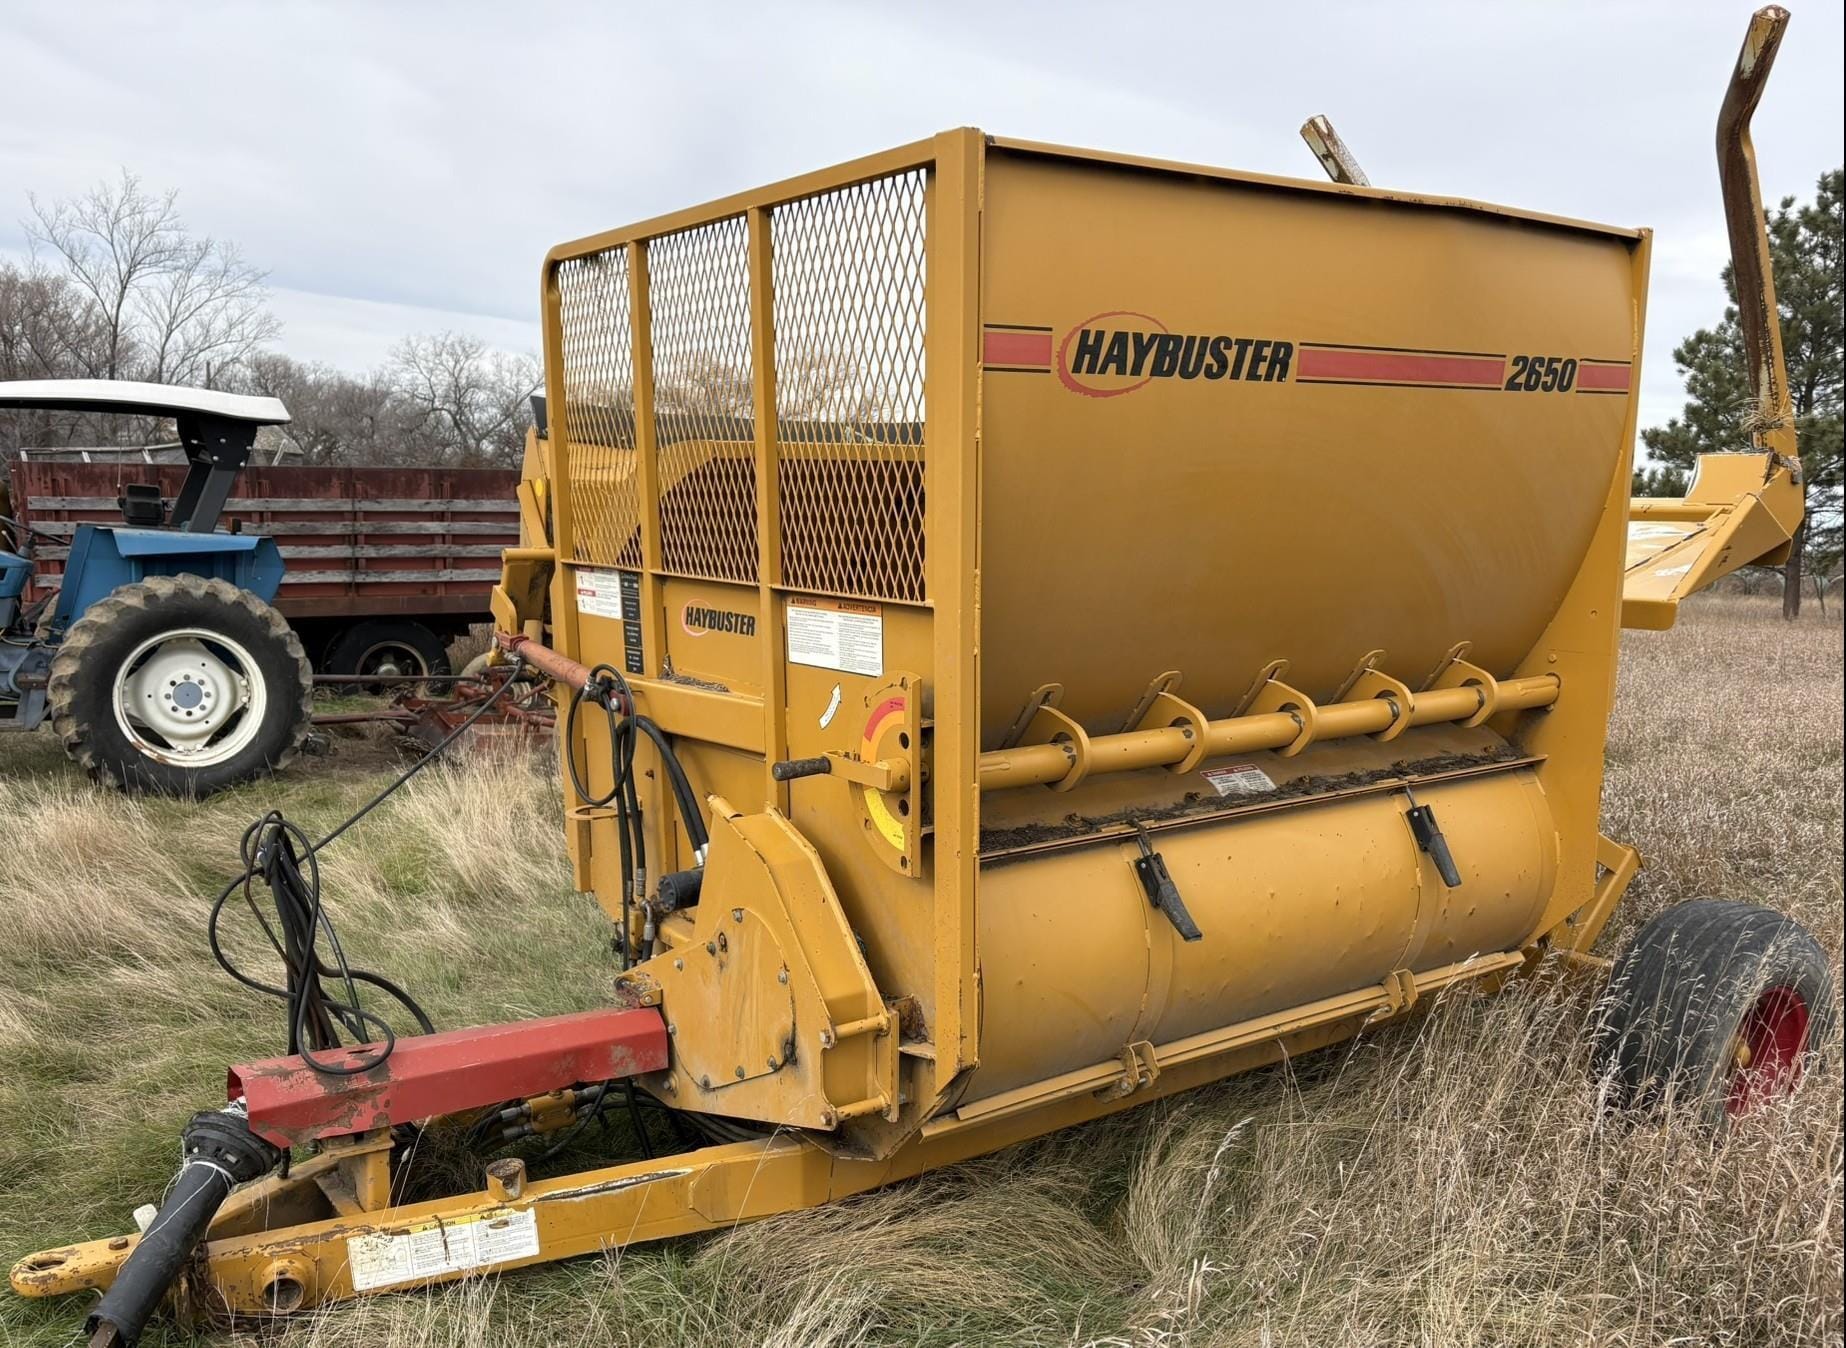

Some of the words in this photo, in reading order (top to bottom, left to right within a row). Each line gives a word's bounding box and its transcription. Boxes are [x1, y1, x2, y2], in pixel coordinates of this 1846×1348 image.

[1071, 328, 1294, 383] HAYBUSTER
[1504, 355, 1578, 393] 2650
[685, 605, 756, 637] HAYBUSTER
